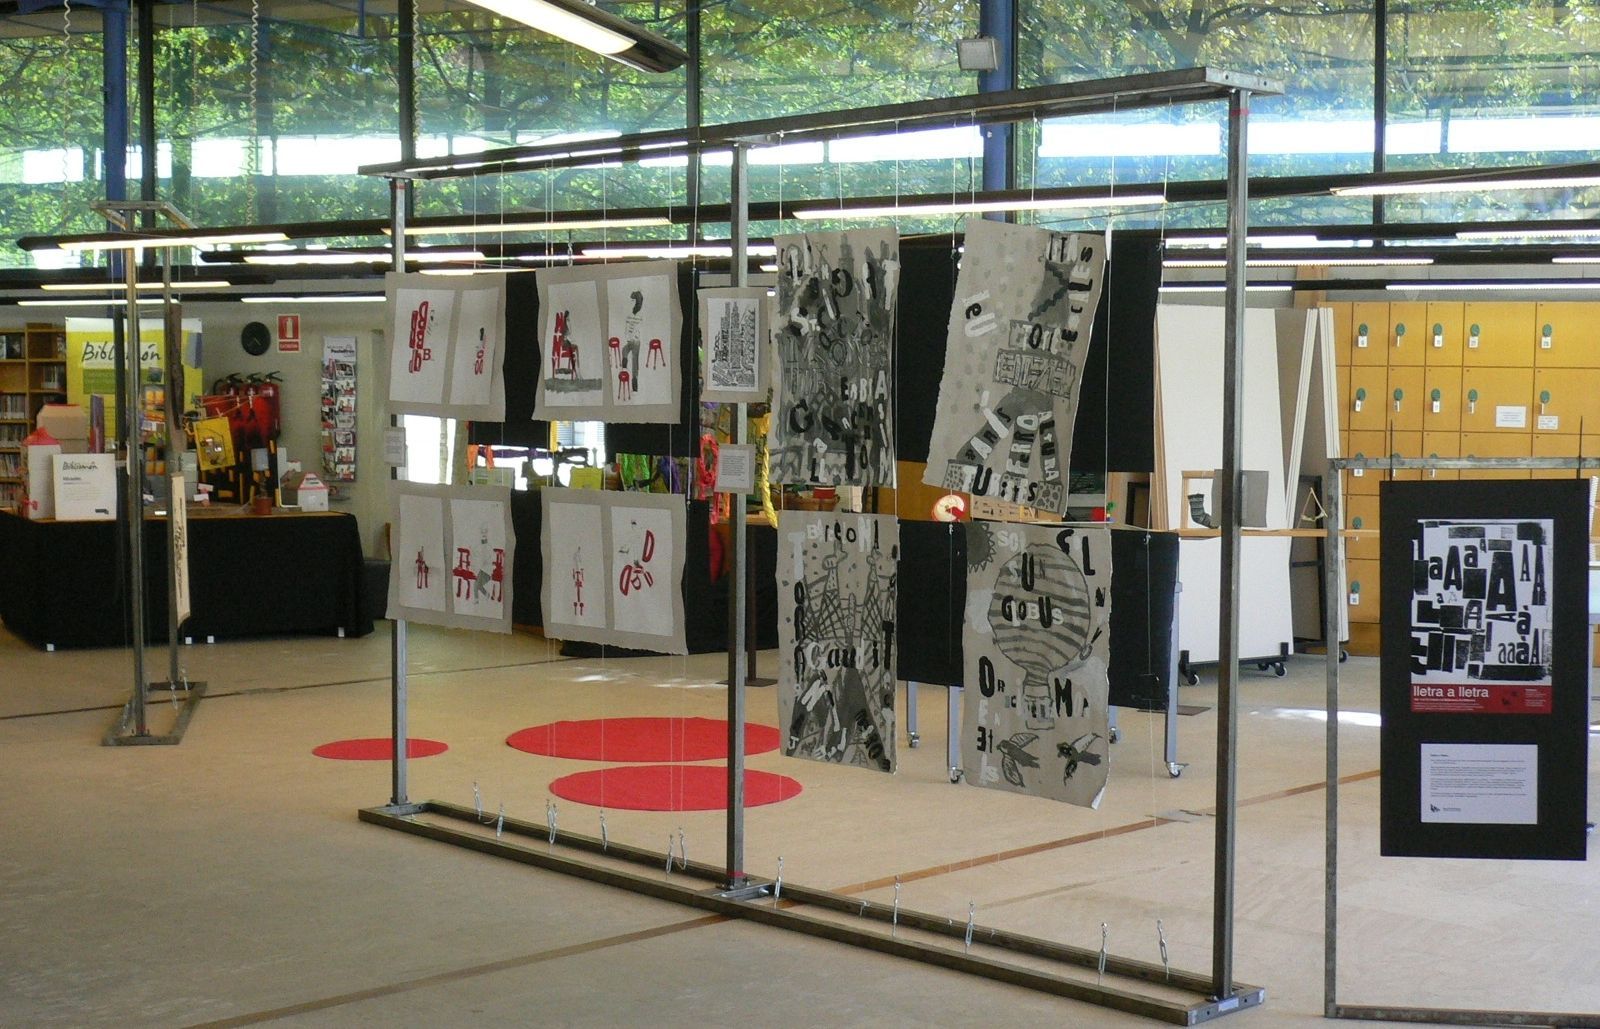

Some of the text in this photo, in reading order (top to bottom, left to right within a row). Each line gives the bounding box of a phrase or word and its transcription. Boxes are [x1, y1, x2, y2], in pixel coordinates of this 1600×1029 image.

[1413, 686, 1489, 698] lletra a lletra
